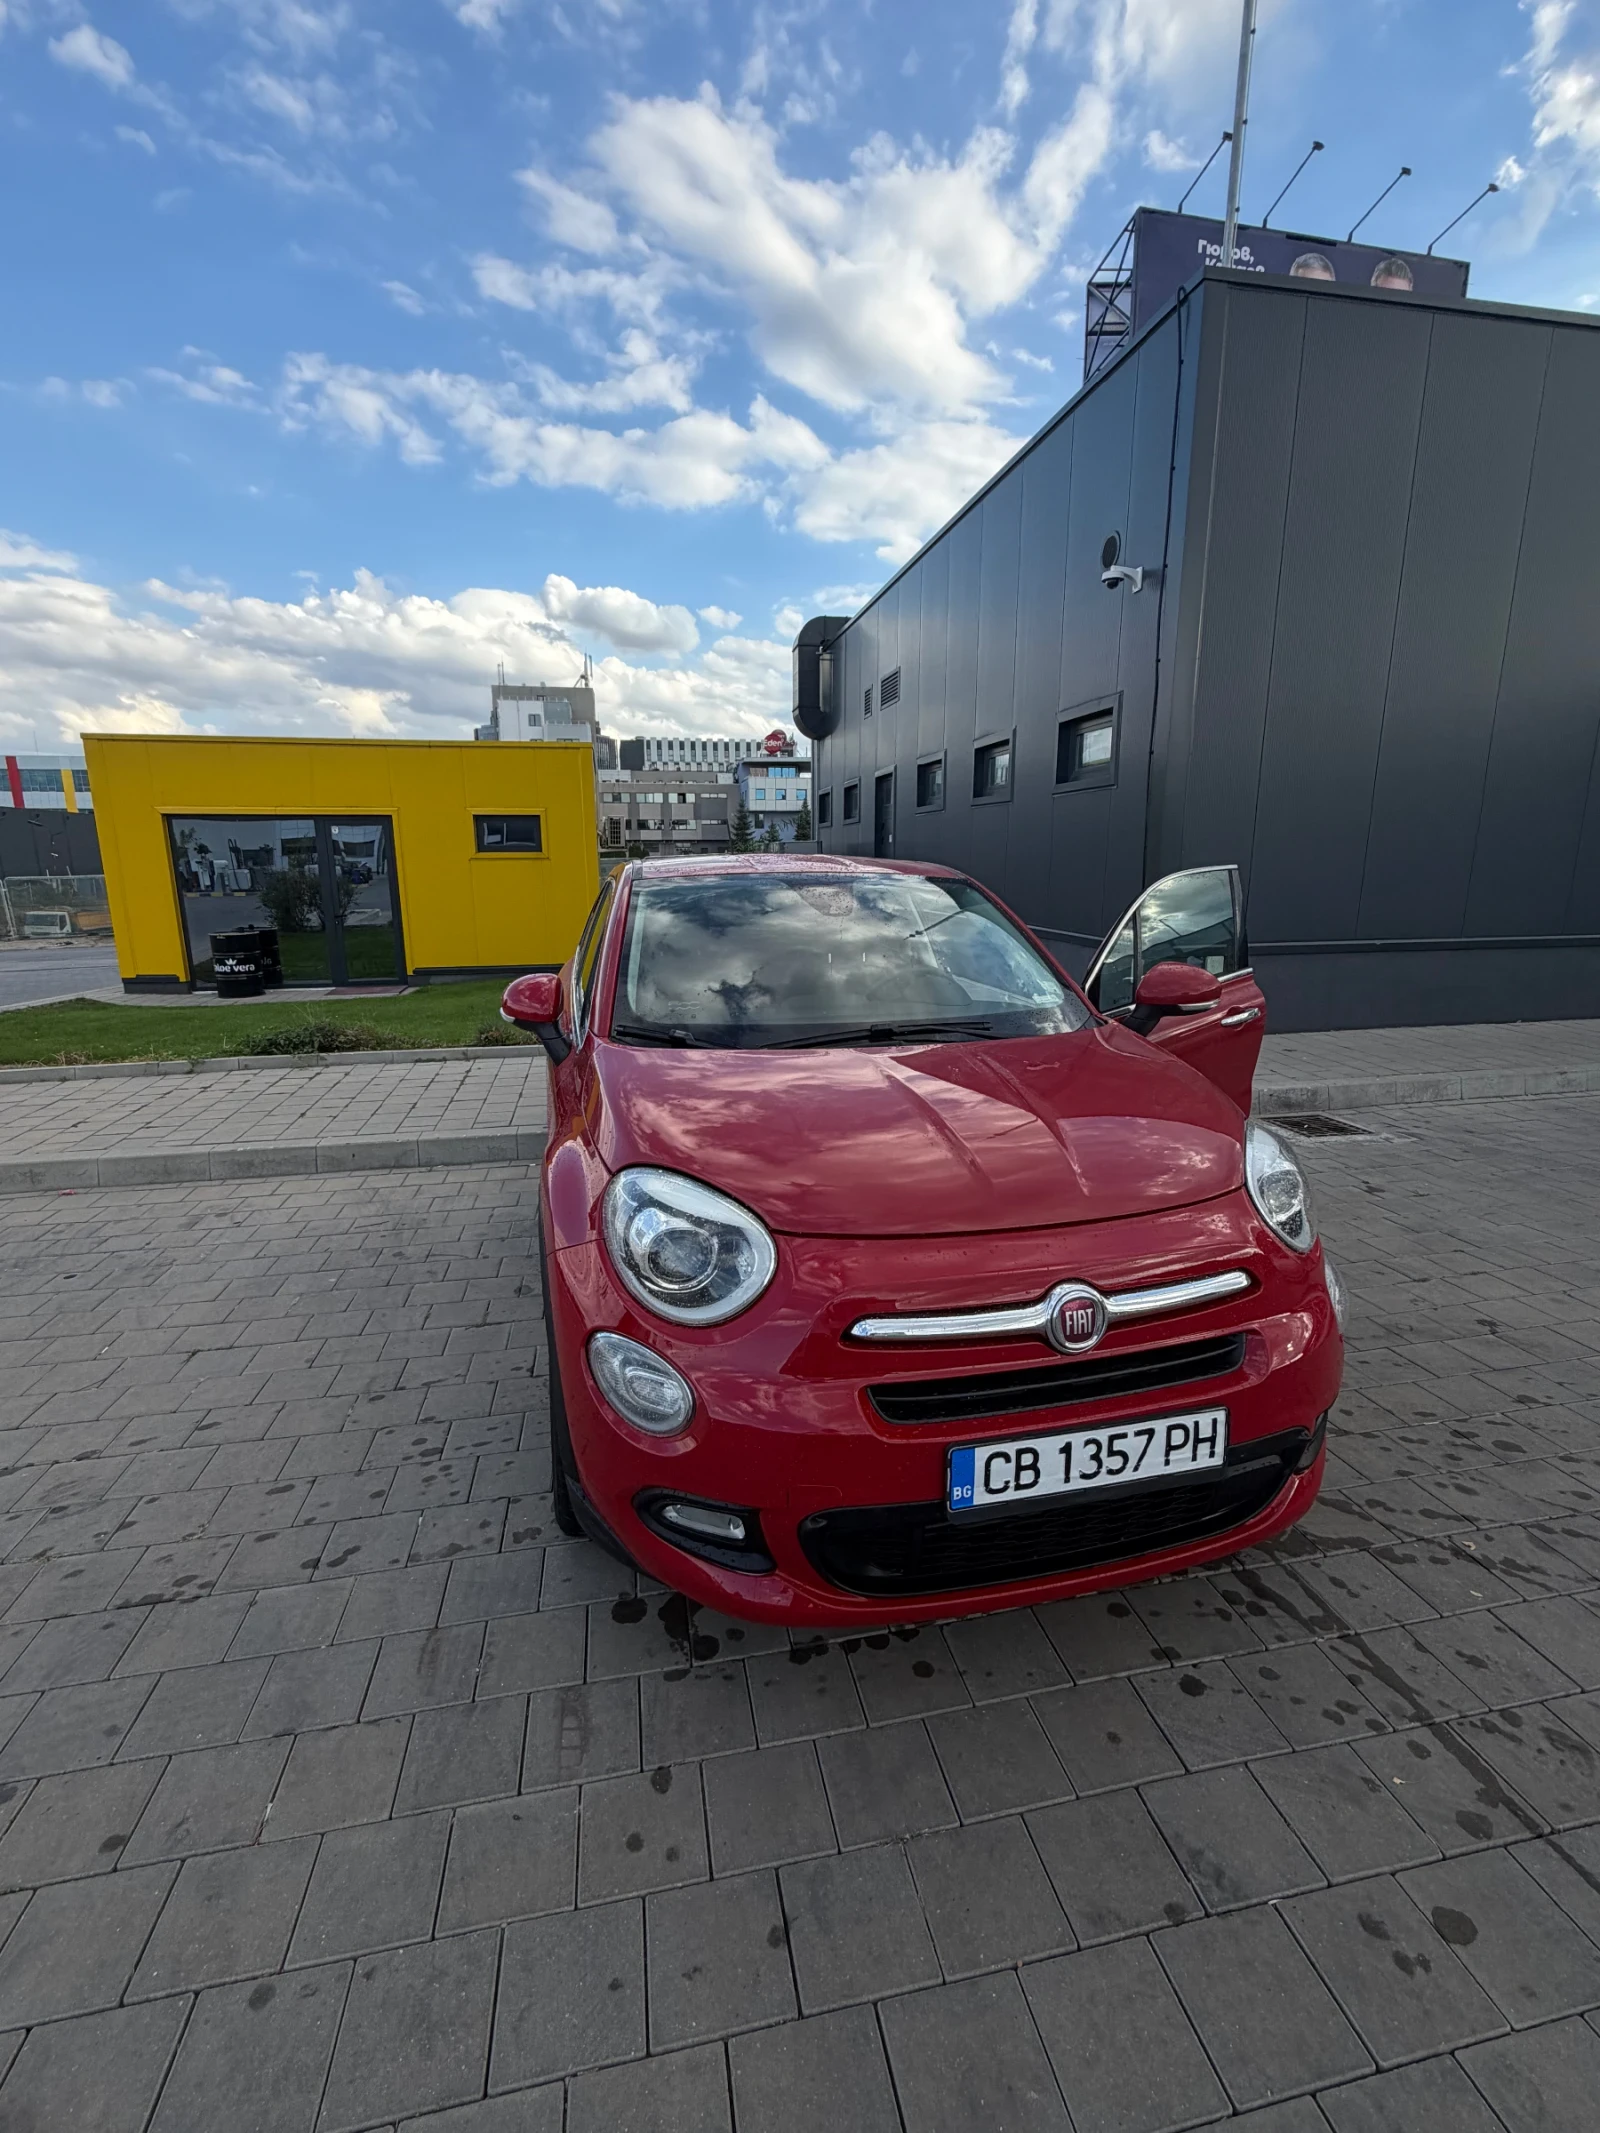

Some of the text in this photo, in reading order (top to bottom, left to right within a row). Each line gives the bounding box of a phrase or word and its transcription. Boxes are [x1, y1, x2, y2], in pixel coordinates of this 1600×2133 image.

[232, 964, 255, 972] vera
[1065, 1308, 1093, 1336] FIAT
[983, 1417, 1218, 1495] CB 1357 PH
[953, 1484, 972, 1501] BG
